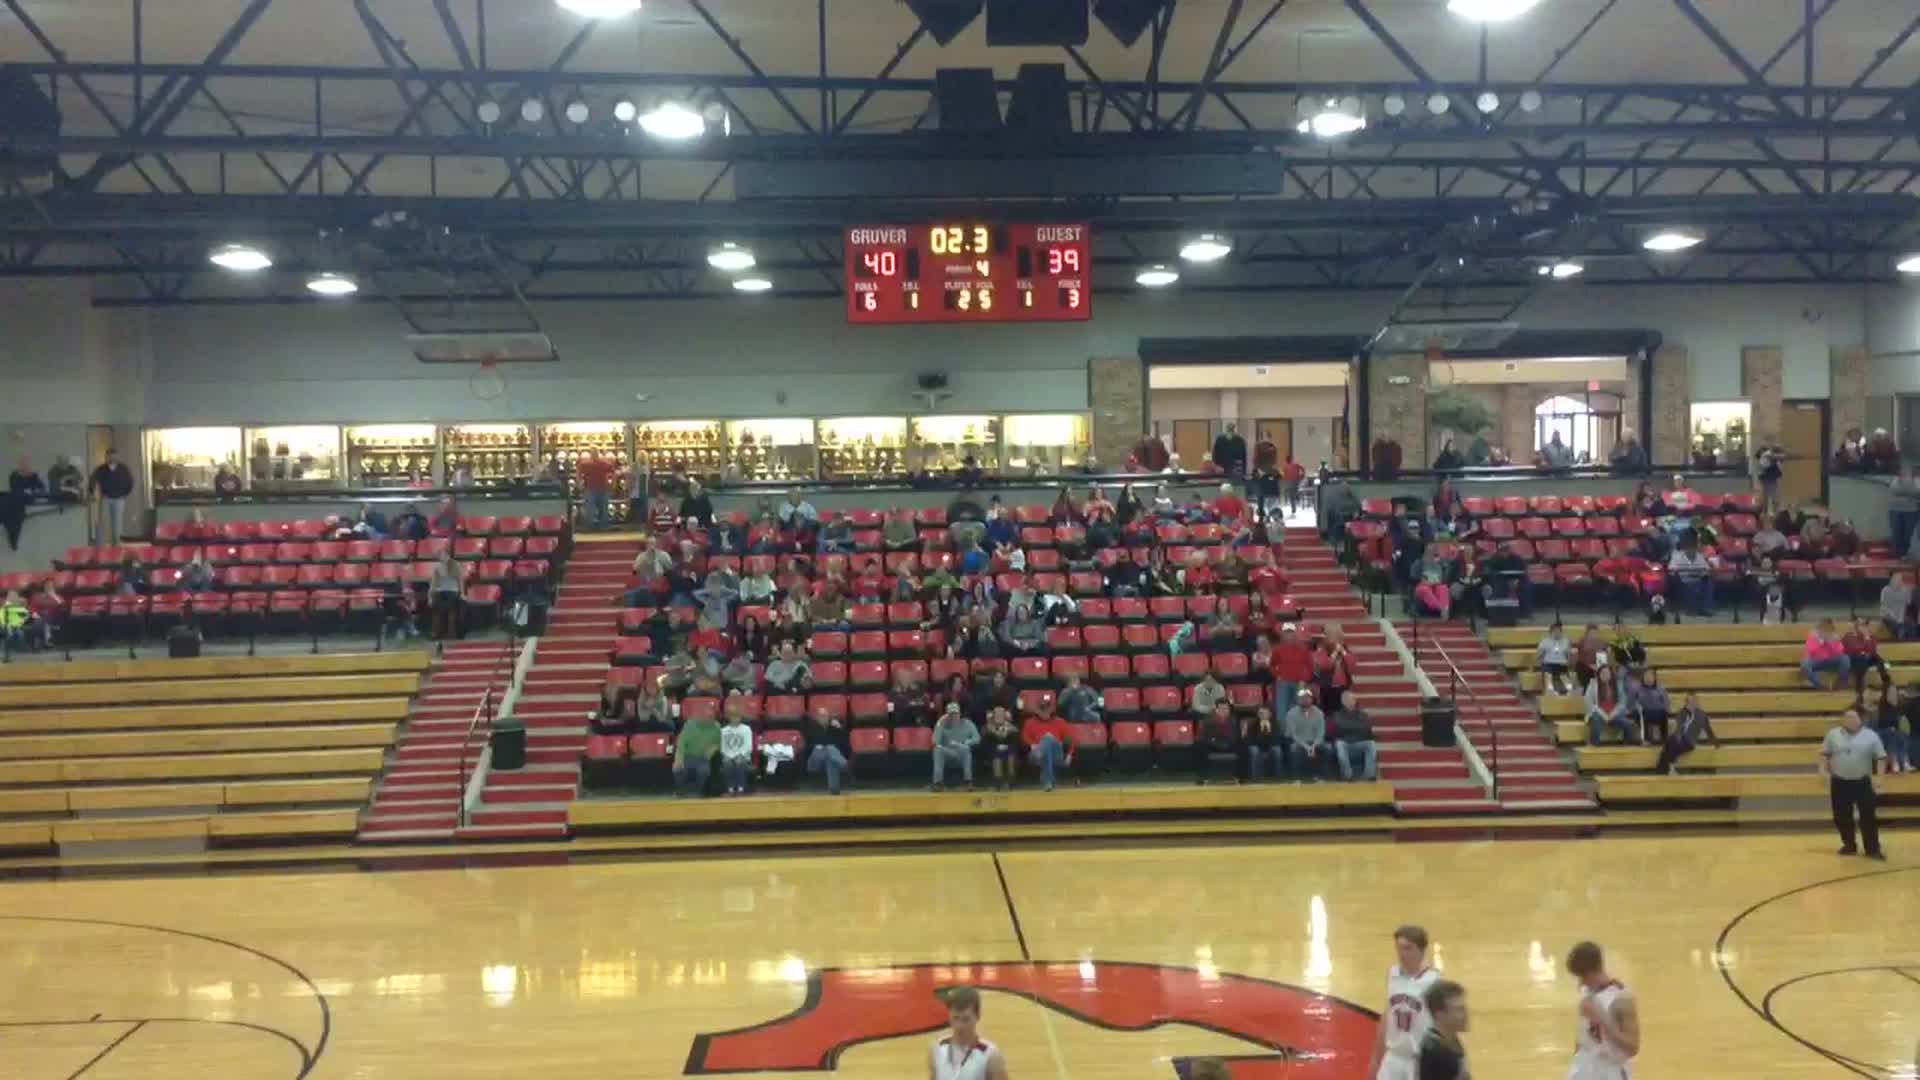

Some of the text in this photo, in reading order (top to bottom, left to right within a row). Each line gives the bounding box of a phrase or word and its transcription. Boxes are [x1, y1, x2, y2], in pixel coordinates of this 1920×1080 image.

[851, 230, 907, 244] GRUVER
[931, 228, 988, 252] 02.3
[1037, 227, 1081, 241] GUEST
[864, 252, 895, 275] 40
[976, 260, 989, 276] 4
[1049, 249, 1079, 274] 39
[865, 292, 876, 310] 6
[911, 292, 918, 308] 1
[1025, 290, 1032, 307] 1
[1069, 288, 1079, 308] 3
